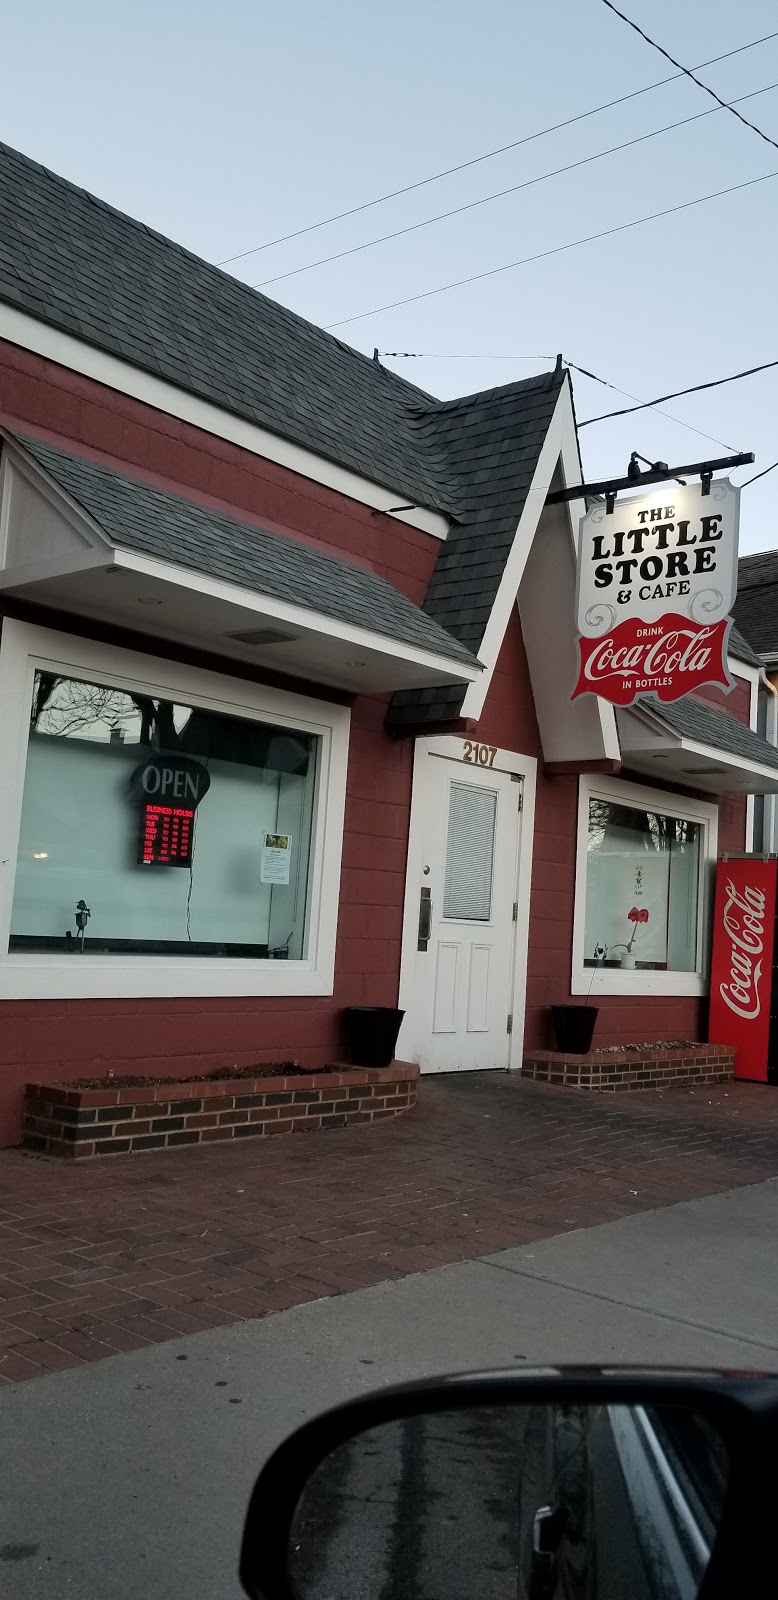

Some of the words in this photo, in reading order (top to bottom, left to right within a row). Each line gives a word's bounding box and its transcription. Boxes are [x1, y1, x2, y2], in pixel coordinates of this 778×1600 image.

[637, 505, 676, 523] THE
[591, 514, 723, 560] LITTLE
[594, 546, 717, 588] STORE
[617, 590, 632, 604] &
[638, 580, 691, 601] CAFE
[636, 626, 664, 638] DRINK
[584, 625, 719, 681] Coca-Cola
[622, 680, 632, 689] IN
[636, 677, 673, 688] BOTTLES
[463, 740, 498, 767] 2107
[142, 765, 200, 800] OPEN
[146, 805, 172, 815] BUSINESS
[173, 809, 194, 818] HOURS
[719, 876, 766, 1020] Coca-Cola
